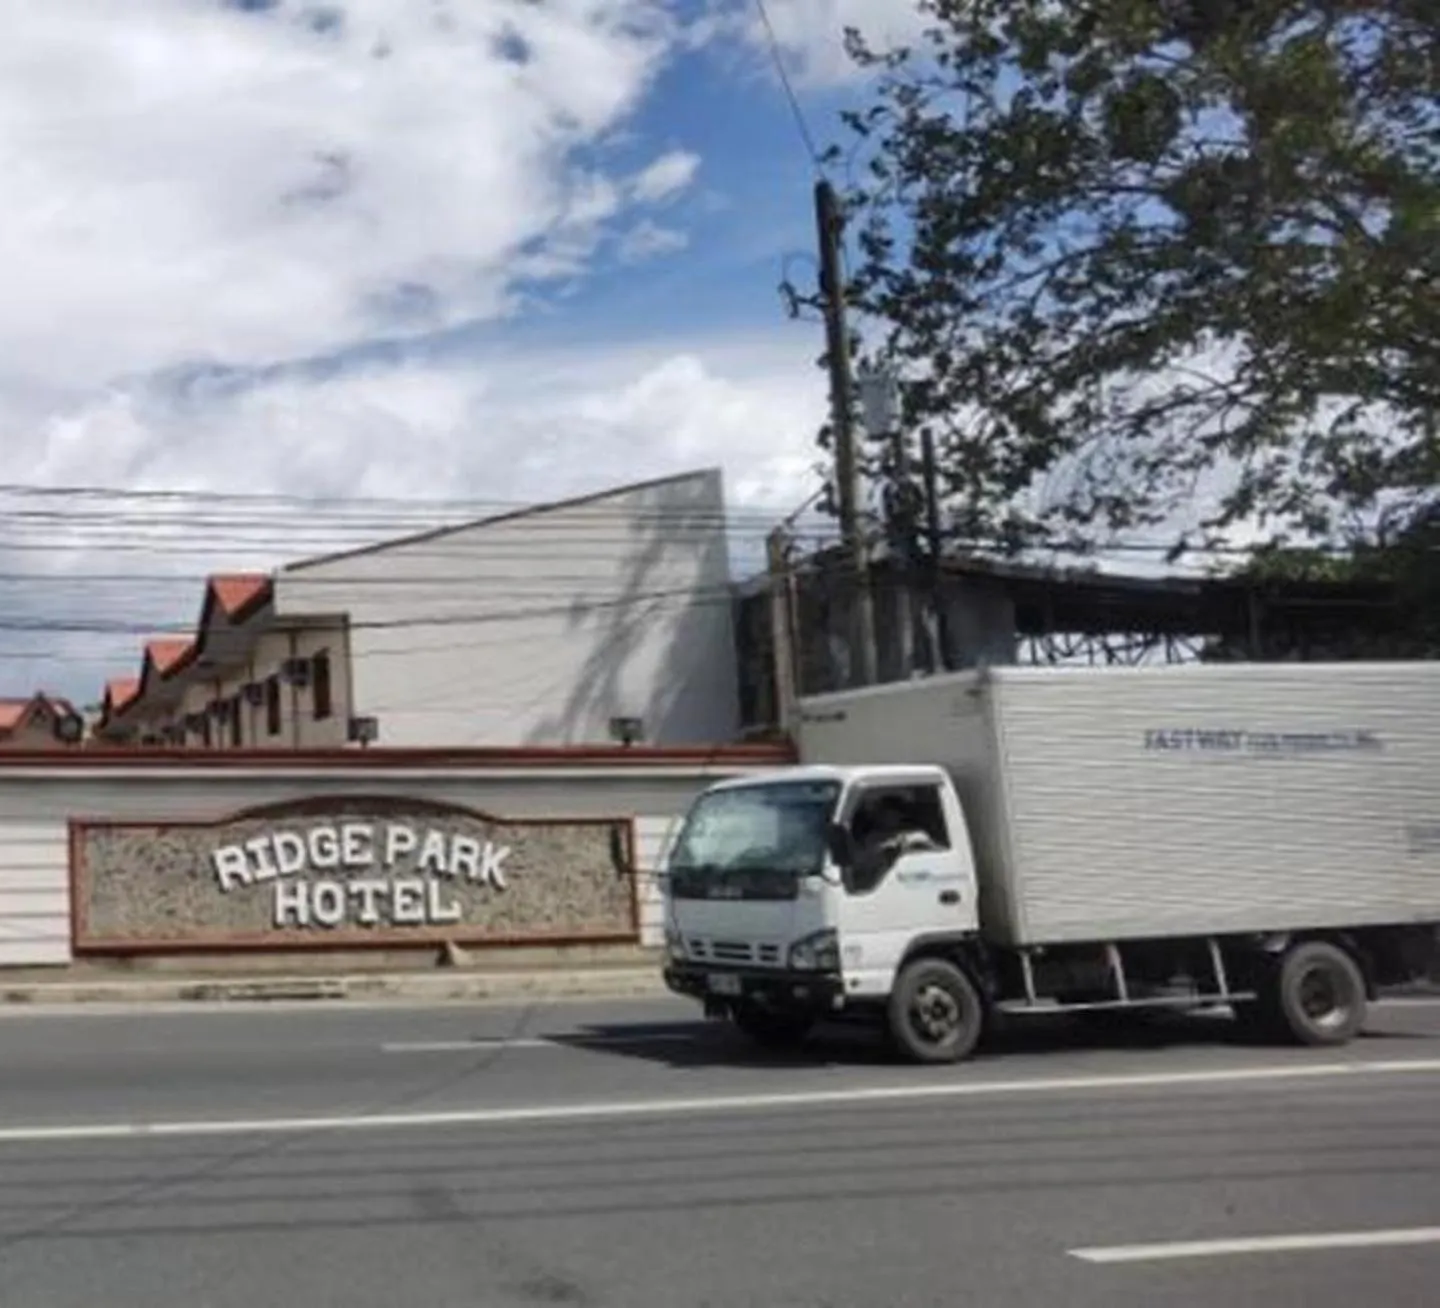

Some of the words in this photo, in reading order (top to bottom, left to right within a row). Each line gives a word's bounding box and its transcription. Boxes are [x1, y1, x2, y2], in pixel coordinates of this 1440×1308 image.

[213, 824, 374, 891] RIDGE
[385, 824, 511, 890] PARK
[274, 880, 462, 926] HOTEL
